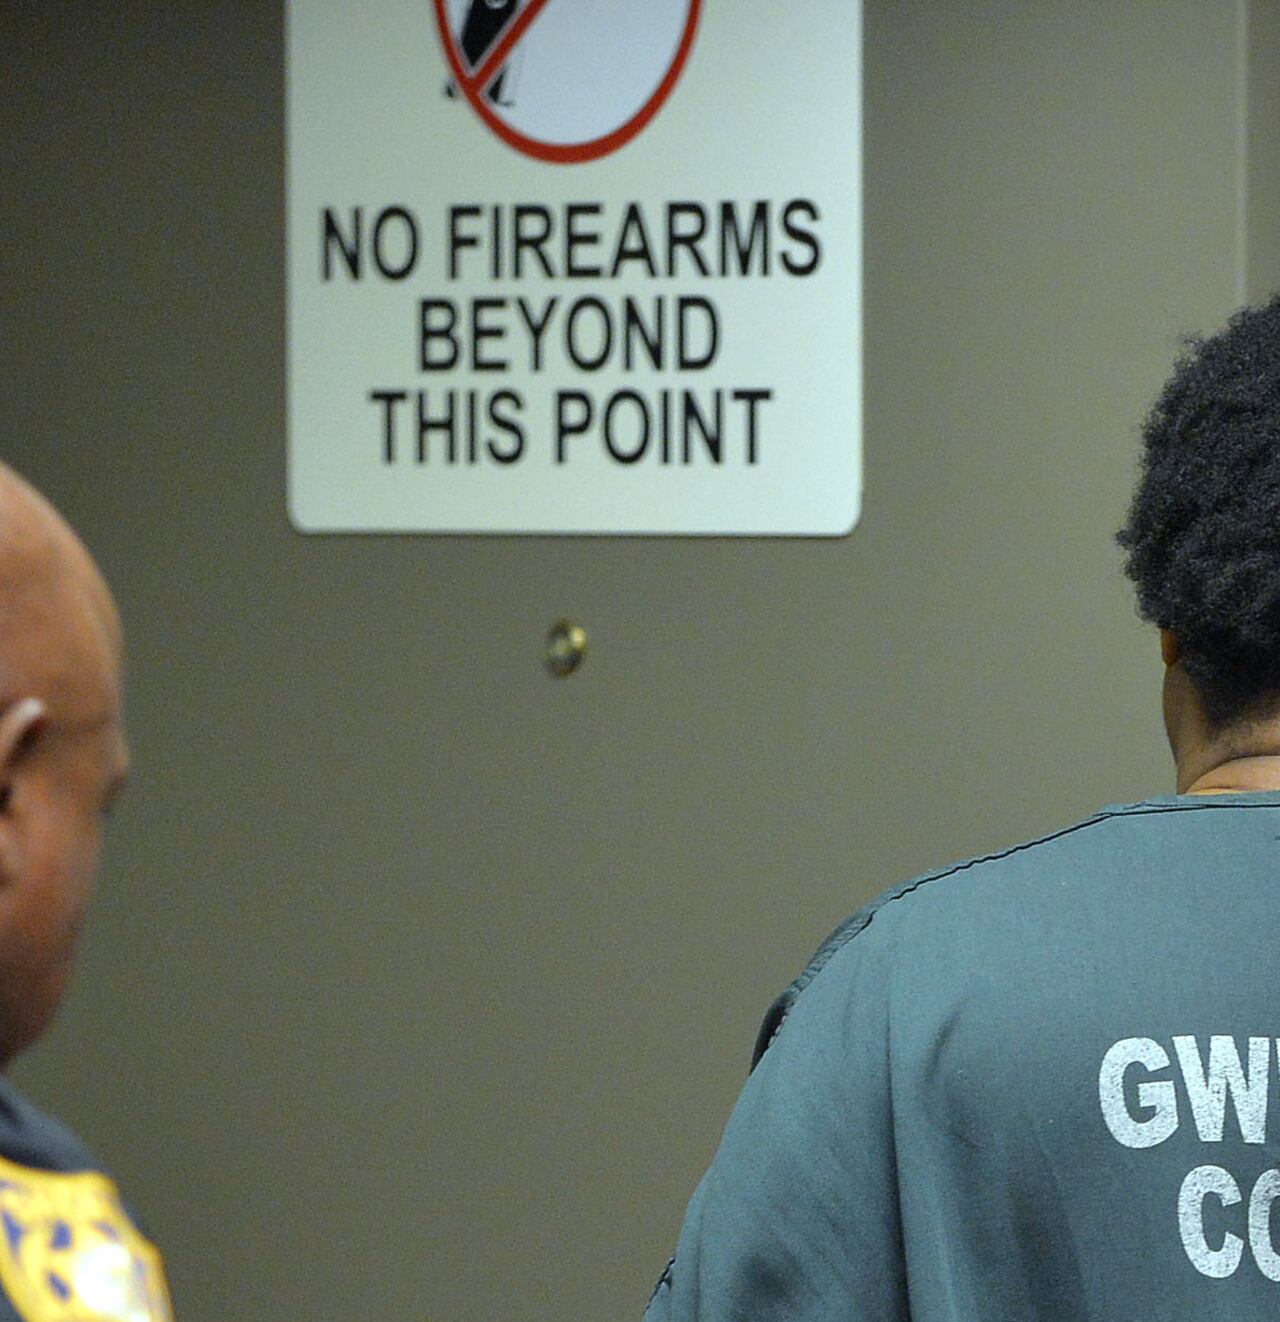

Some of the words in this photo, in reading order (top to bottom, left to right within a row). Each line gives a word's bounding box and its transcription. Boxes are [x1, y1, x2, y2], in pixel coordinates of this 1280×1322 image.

[322, 204, 418, 281] NO
[447, 199, 822, 279] FIREARMS
[418, 295, 720, 373] BEYOND
[370, 388, 525, 466] THIS
[554, 387, 774, 466] POINT
